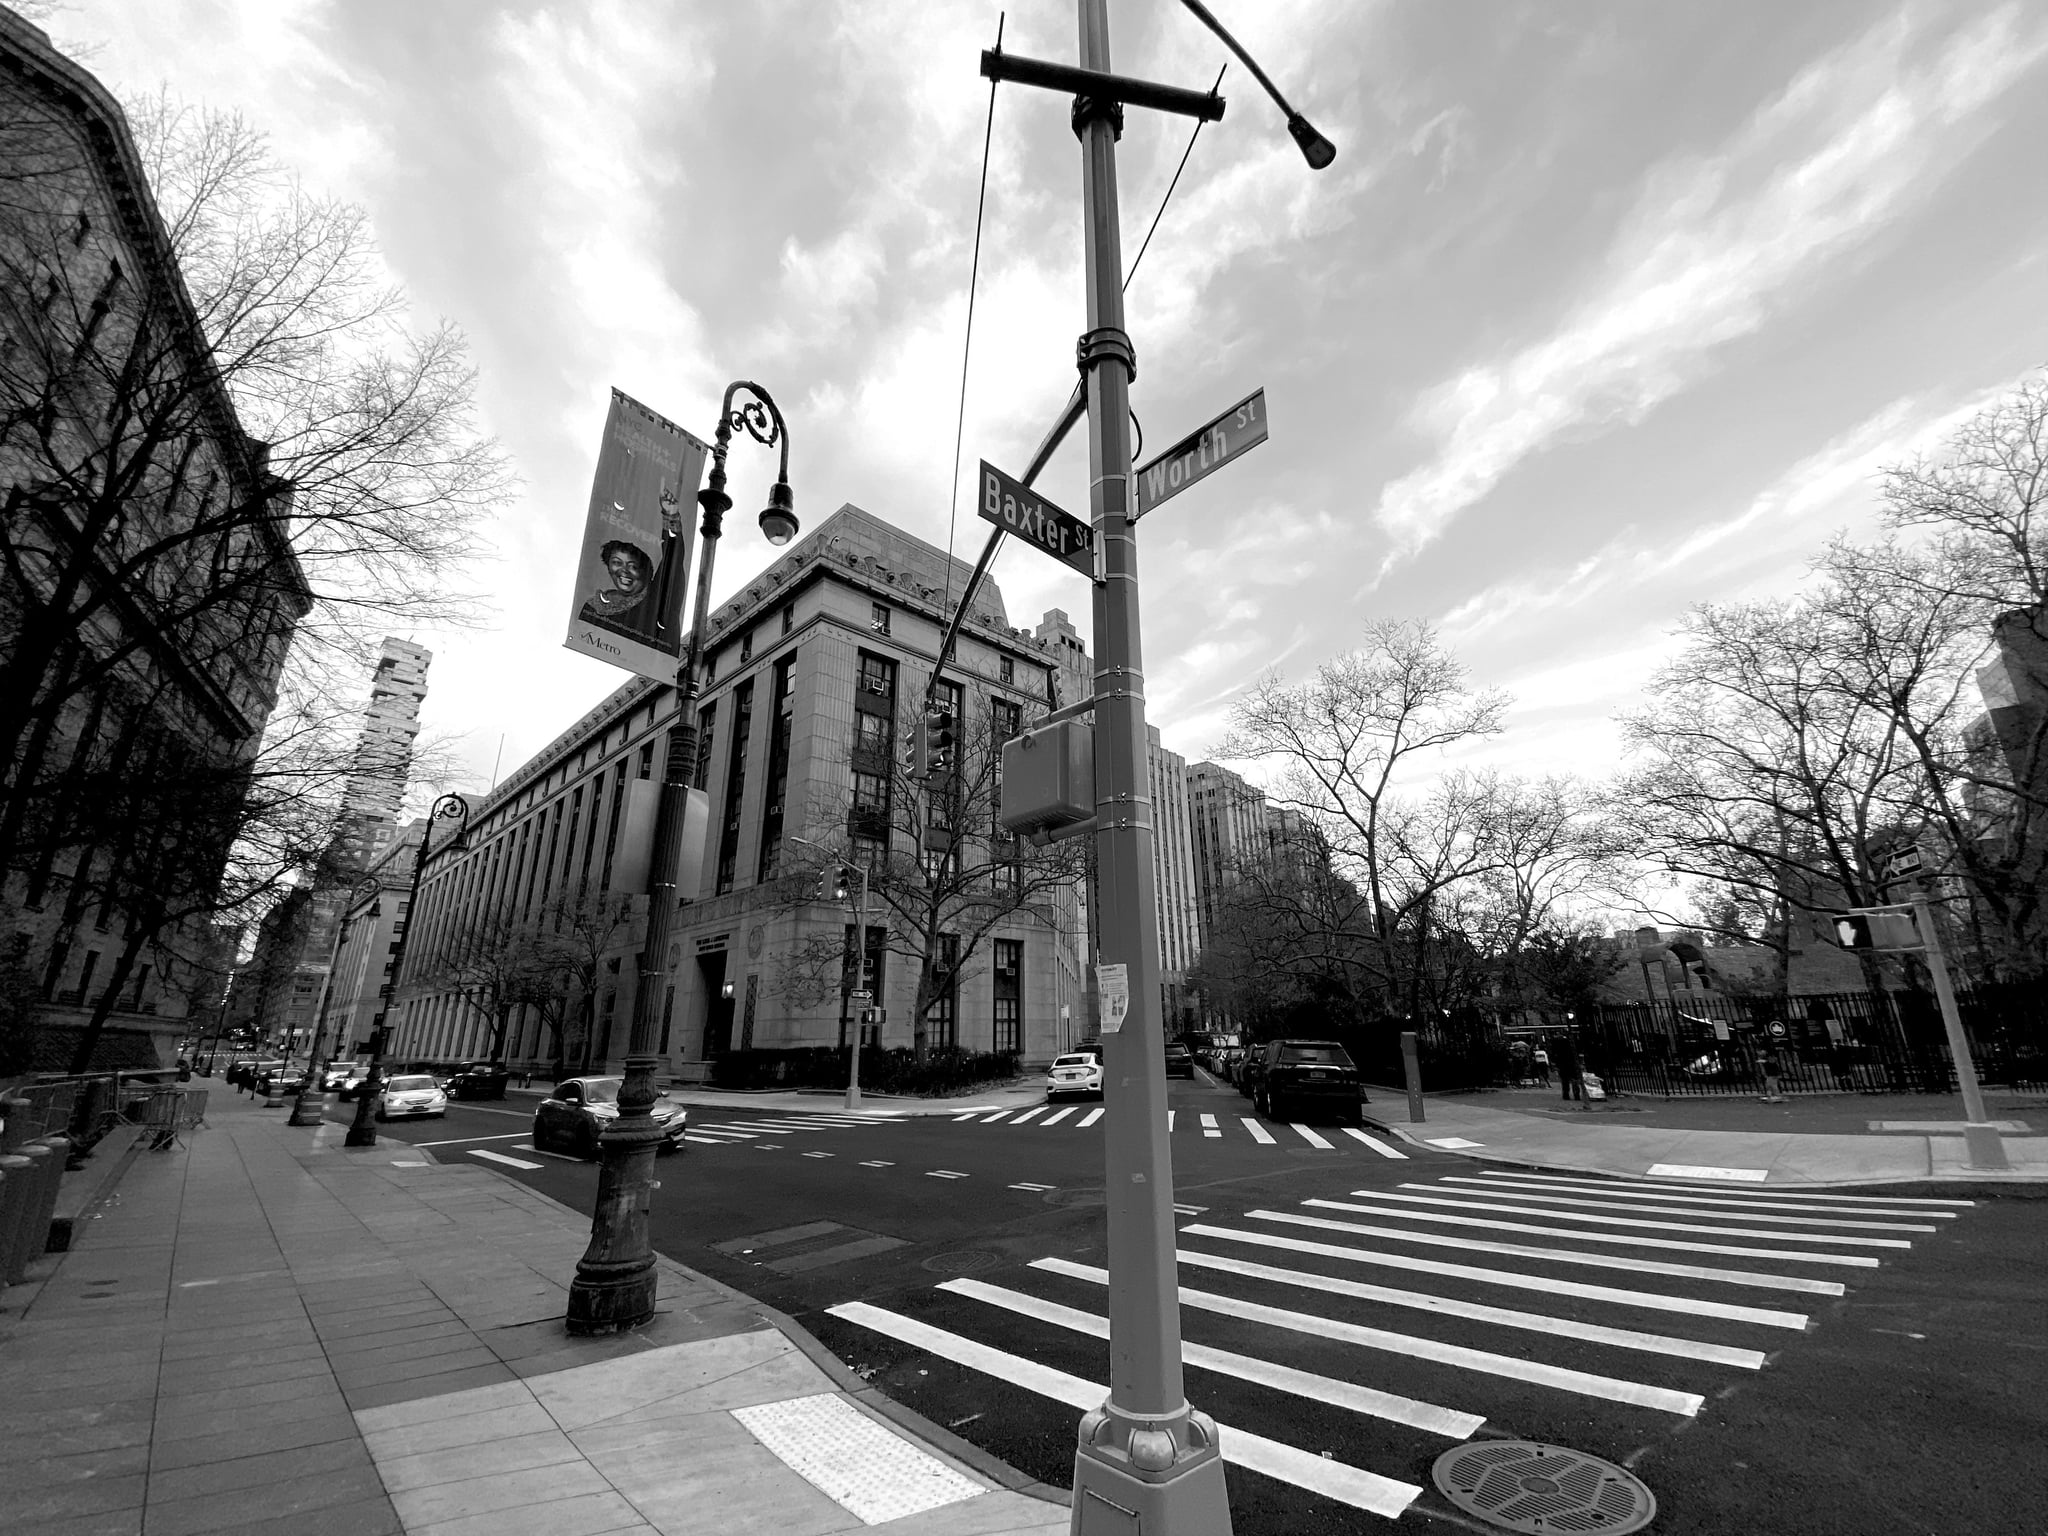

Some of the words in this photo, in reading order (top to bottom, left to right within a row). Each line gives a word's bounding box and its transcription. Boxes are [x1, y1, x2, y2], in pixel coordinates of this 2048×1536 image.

[1145, 427, 1228, 502] Worth
[1236, 398, 1257, 429] St
[599, 511, 664, 547] RECOVERY
[984, 470, 1069, 555] Baxter
[1075, 523, 1090, 551] St
